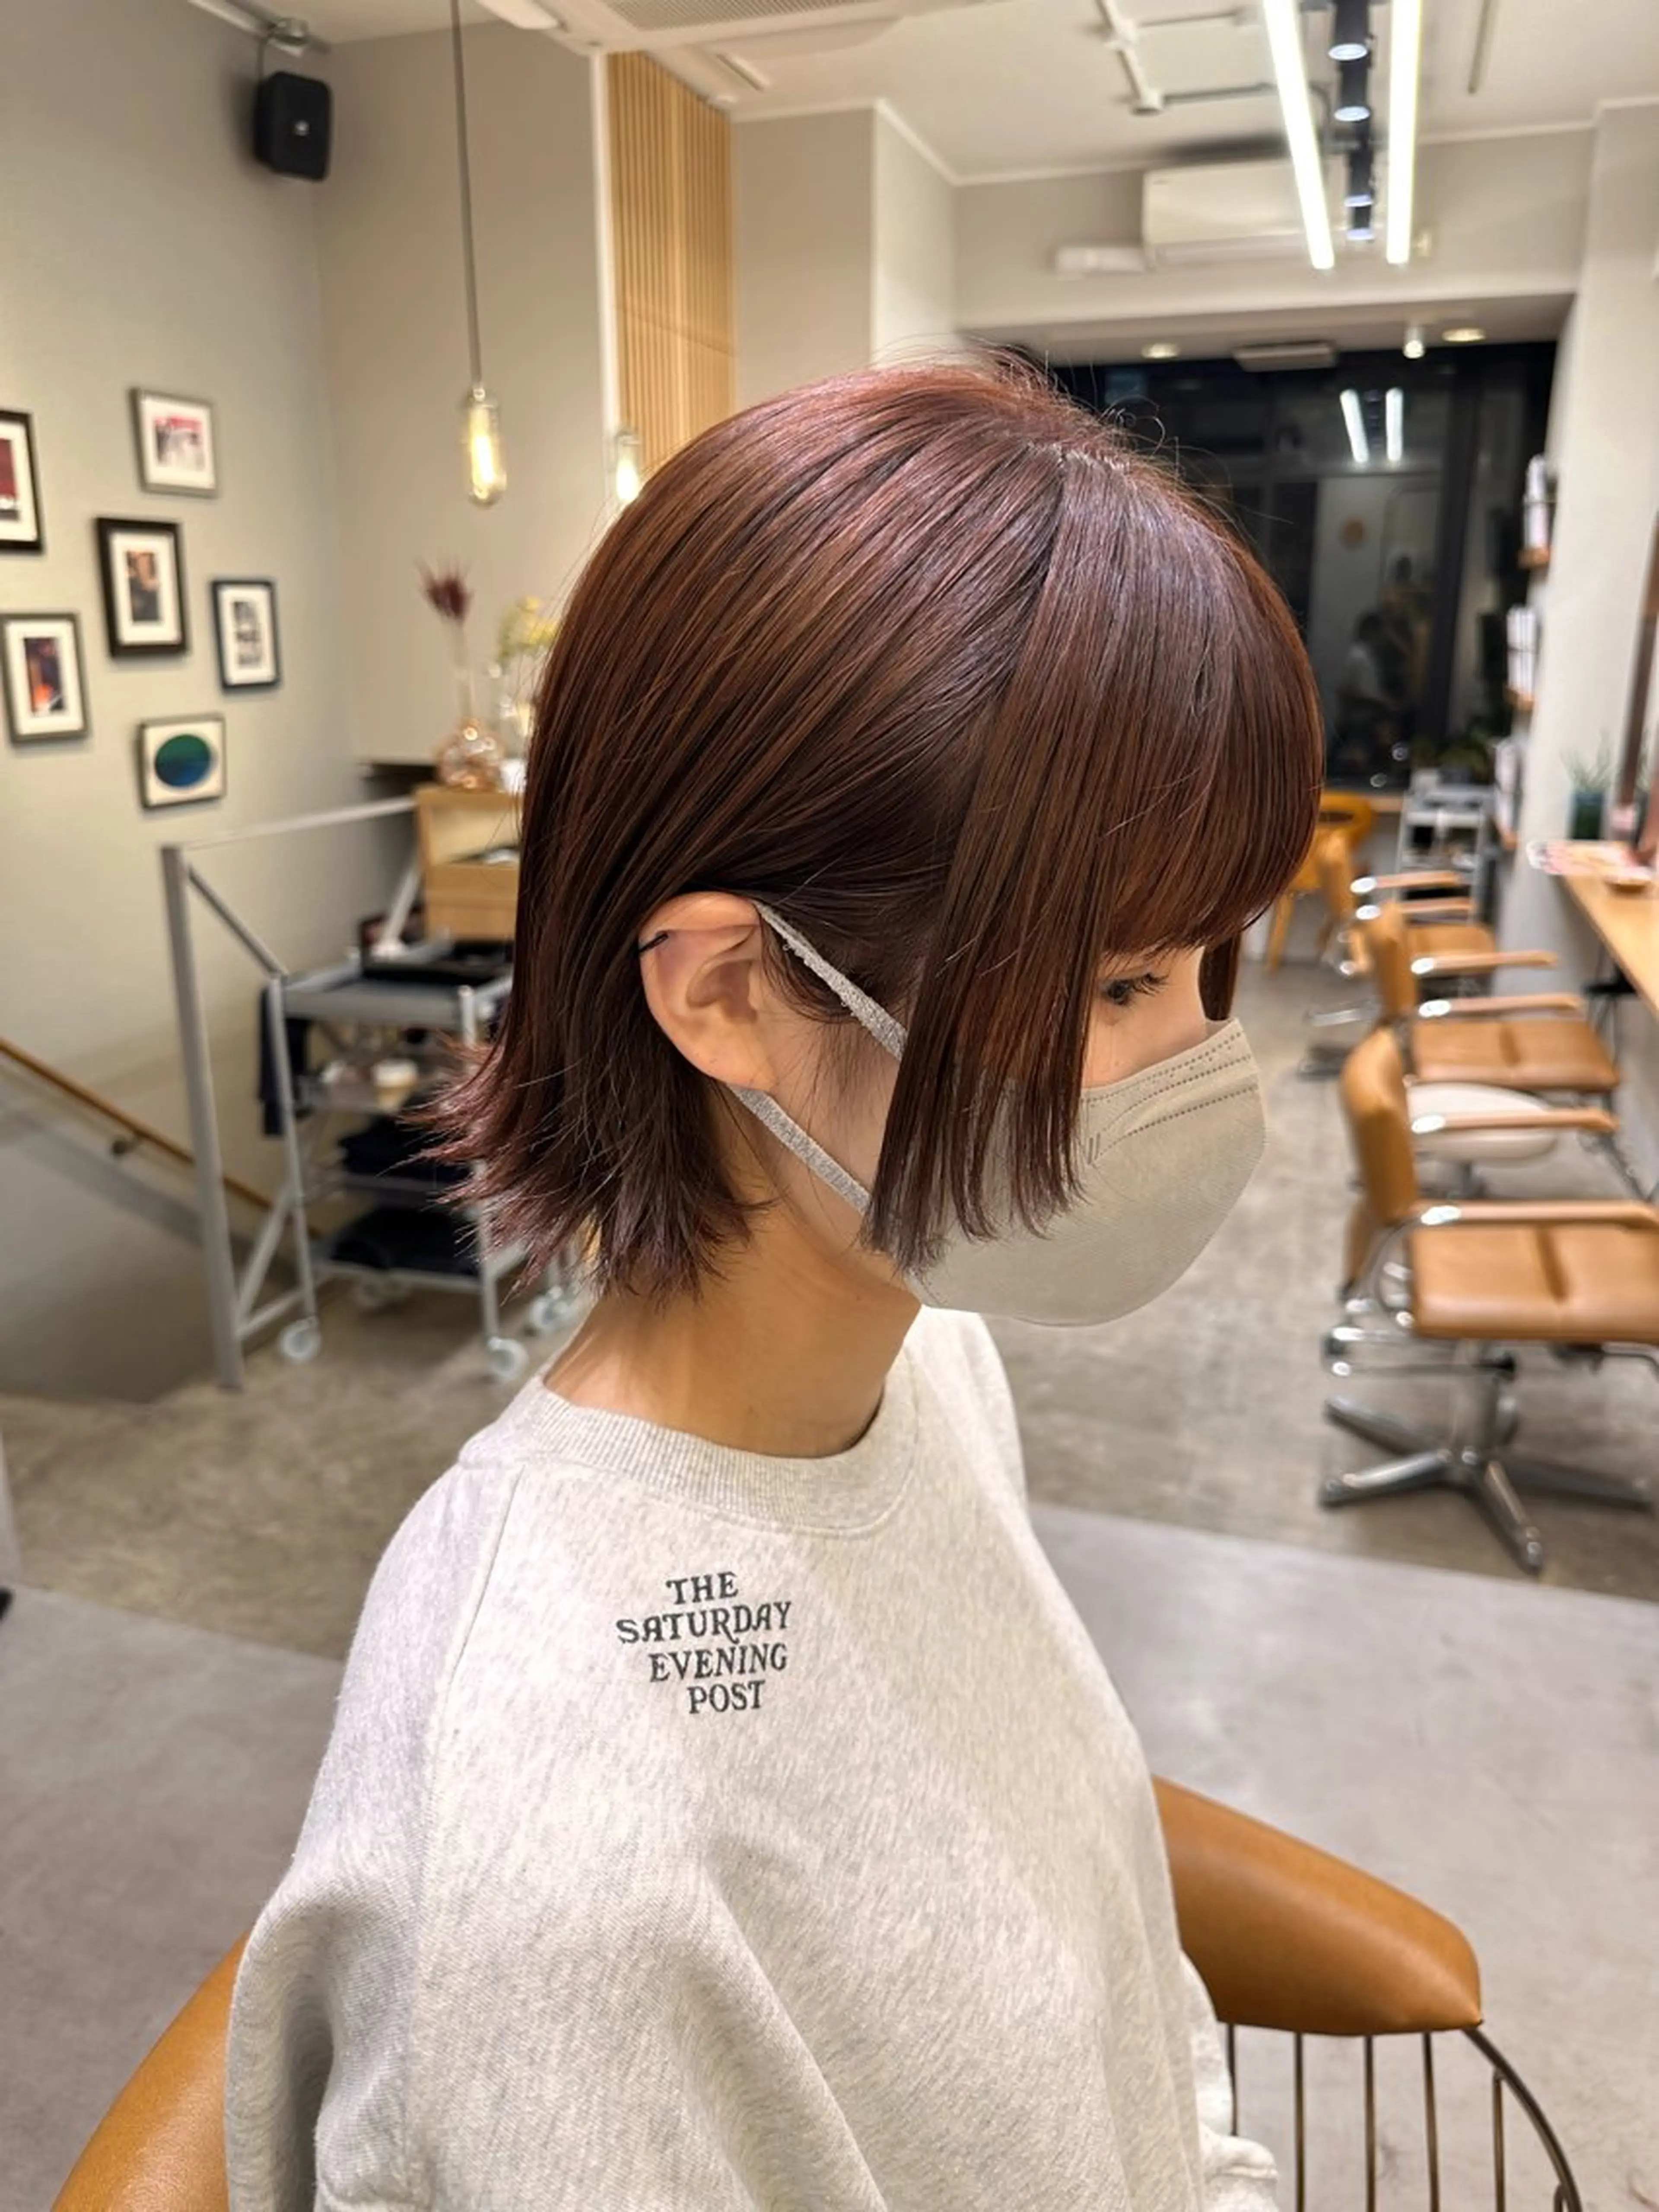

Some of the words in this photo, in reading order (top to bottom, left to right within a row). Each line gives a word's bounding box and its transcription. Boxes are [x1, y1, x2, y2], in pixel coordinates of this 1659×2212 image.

[666, 1571, 739, 1605] THE
[616, 1601, 791, 1644] SATURDAY
[649, 1643, 787, 1682] EVENING
[687, 1680, 766, 1714] POST
